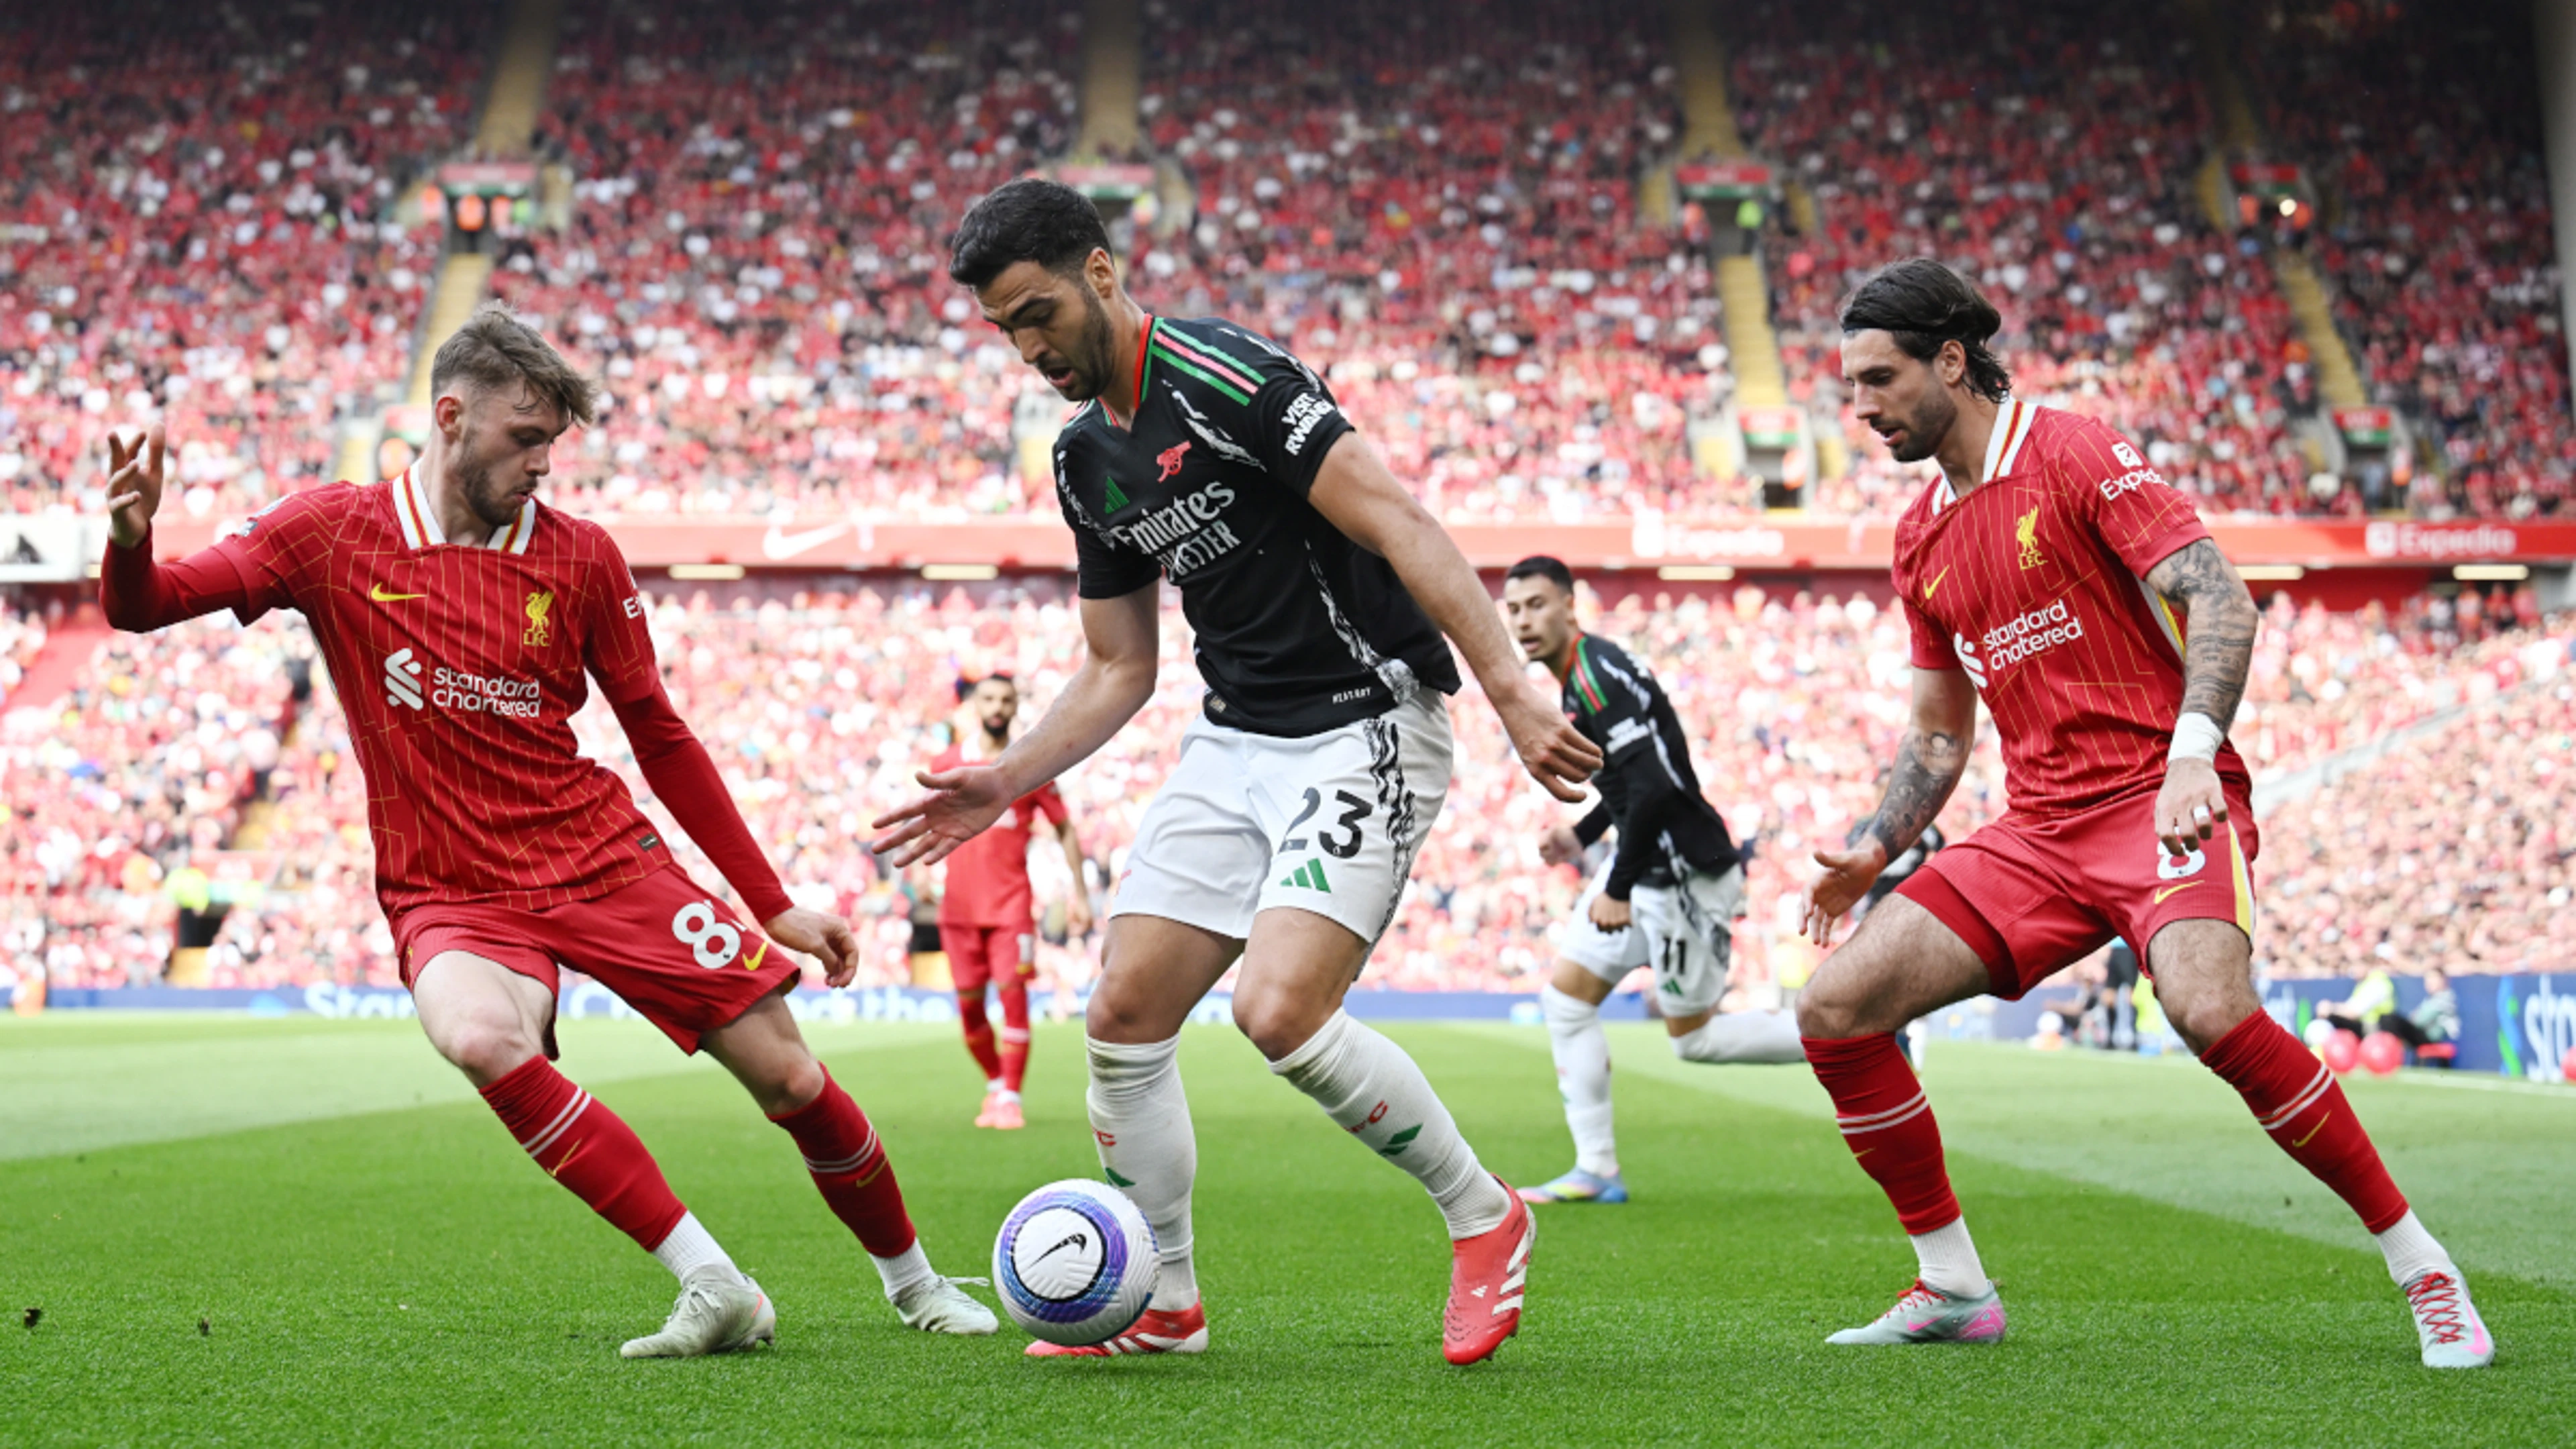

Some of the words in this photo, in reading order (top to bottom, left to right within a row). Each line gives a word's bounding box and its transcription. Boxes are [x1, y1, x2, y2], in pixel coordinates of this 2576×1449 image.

[1110, 481, 1236, 554] Emirates
[433, 667, 540, 698] standard
[433, 687, 542, 718] chartered
[1279, 787, 1373, 859] 23
[2157, 825, 2206, 879] 8
[672, 902, 741, 969] 8
[1663, 936, 1686, 975] 11
